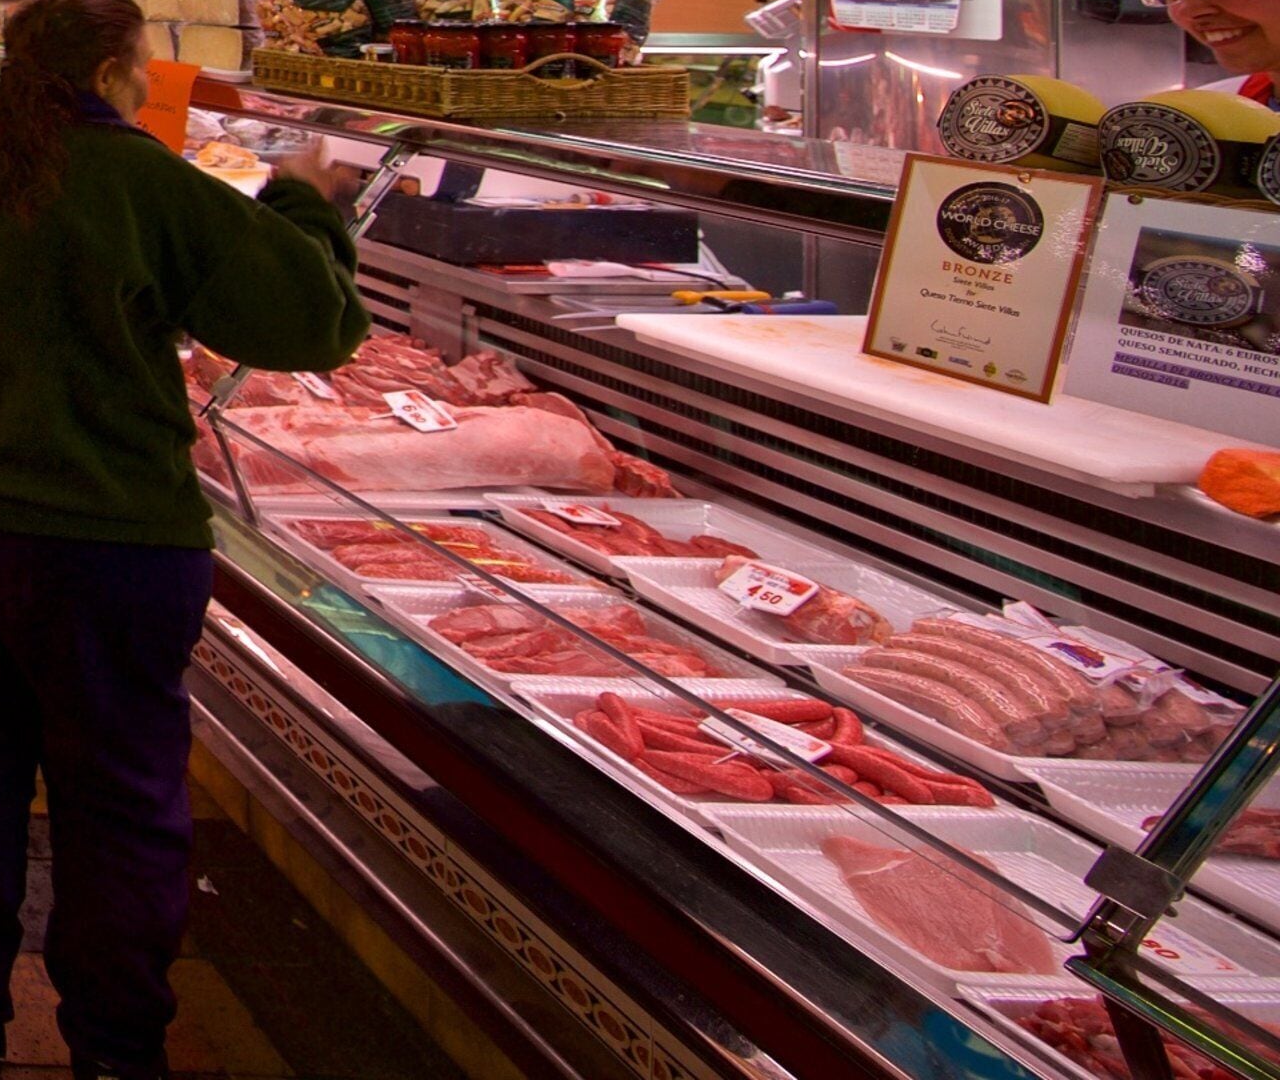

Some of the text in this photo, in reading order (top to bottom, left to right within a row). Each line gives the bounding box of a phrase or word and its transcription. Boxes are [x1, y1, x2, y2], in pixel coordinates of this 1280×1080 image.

[965, 116, 1010, 136] Villas
[941, 210, 1041, 236] WORLD CHEESE
[942, 261, 1014, 285] BRONZE
[920, 288, 946, 301] Queso
[1118, 338, 1156, 353] QUESO
[1121, 327, 1165, 342] QUESOS
[1168, 336, 1184, 347] DE
[1226, 349, 1233, 357] 6
[1236, 351, 1279, 366] EUROS
